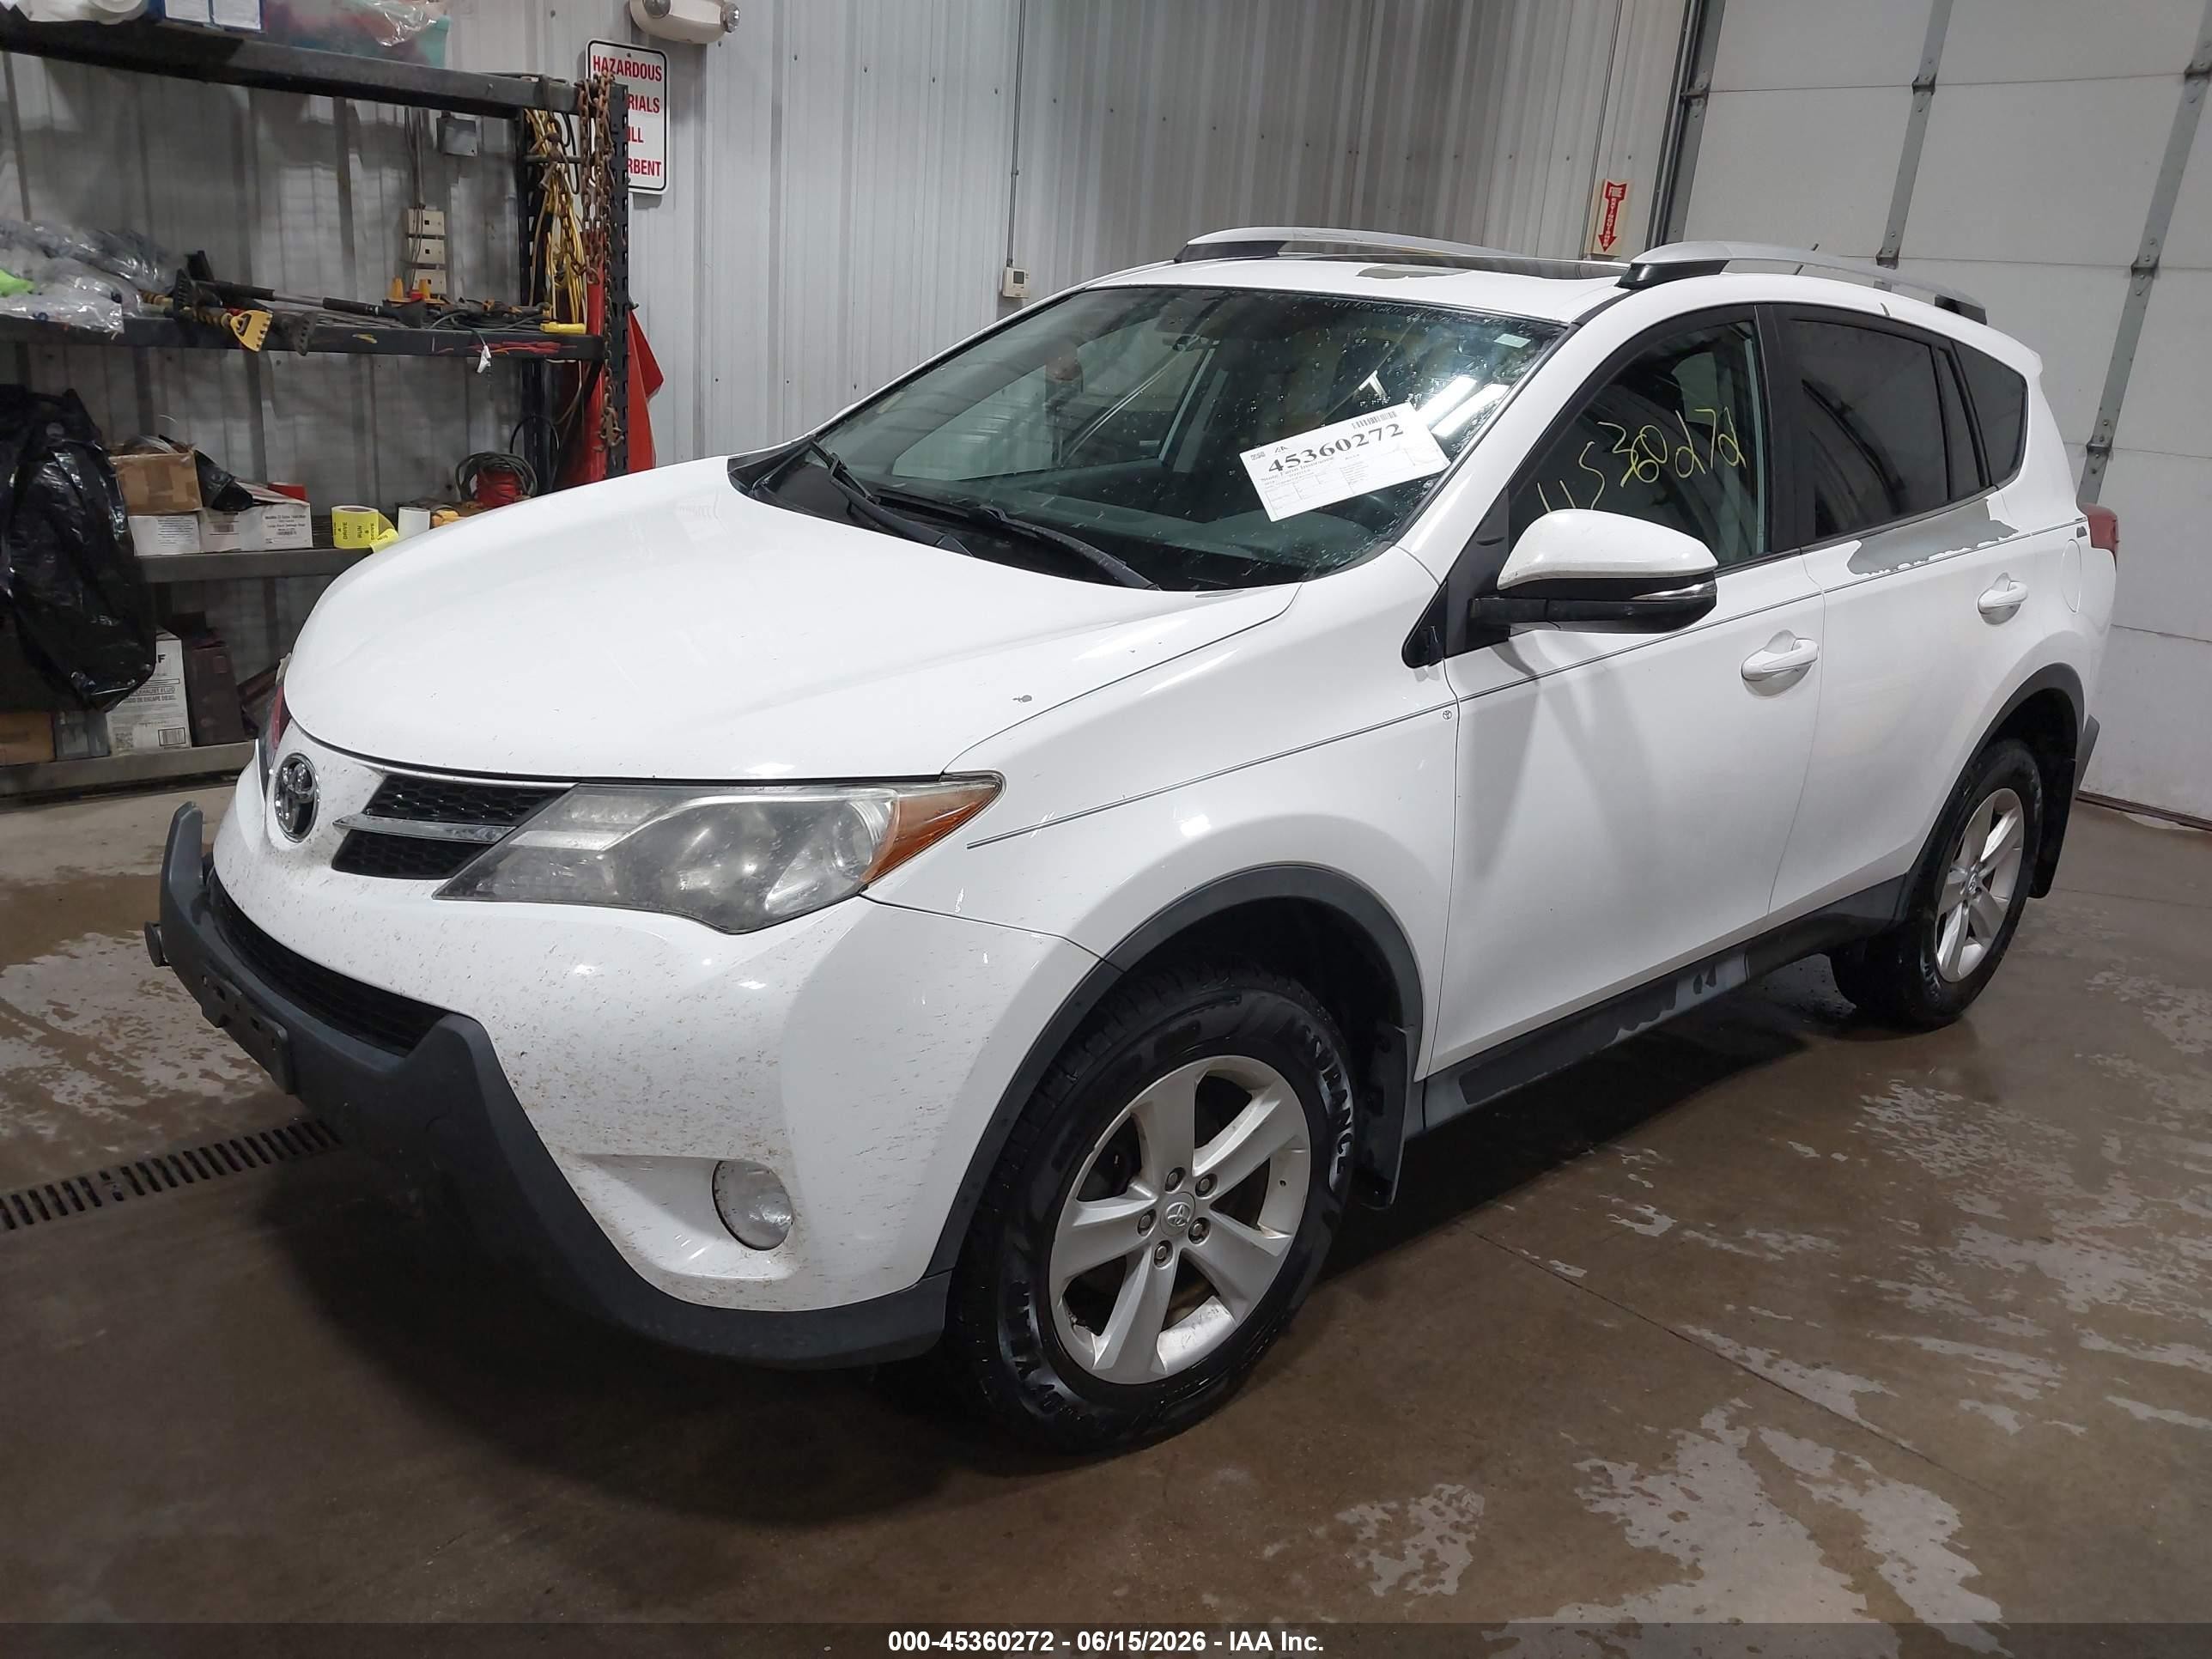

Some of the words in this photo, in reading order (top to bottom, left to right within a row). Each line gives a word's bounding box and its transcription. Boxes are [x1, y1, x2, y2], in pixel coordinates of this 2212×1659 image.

[593, 55, 662, 82] HAZARDOUS
[628, 94, 660, 113] RIALS
[627, 158, 661, 176] RBENT
[1268, 423, 1404, 472] 45360272
